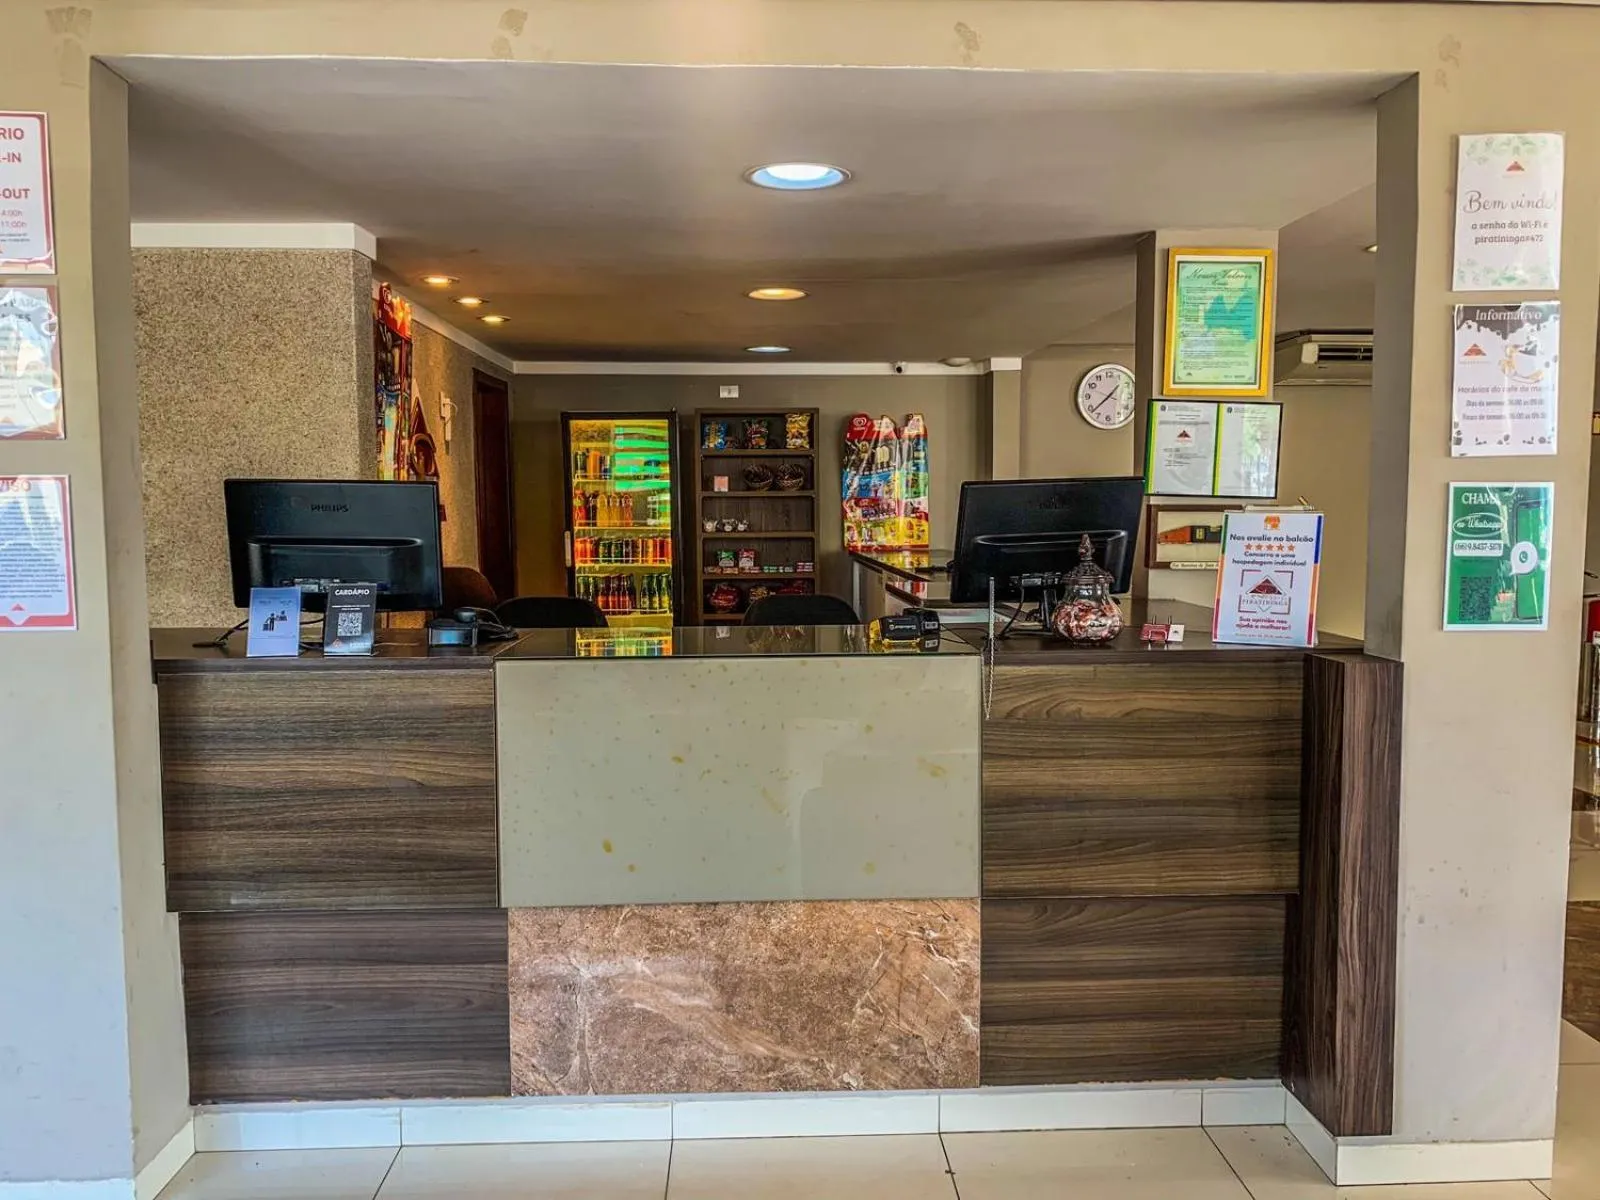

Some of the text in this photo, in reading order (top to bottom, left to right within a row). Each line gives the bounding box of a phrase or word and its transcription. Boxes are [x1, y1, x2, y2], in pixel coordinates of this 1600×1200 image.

[0, 152, 22, 163] -IN
[1463, 190, 1506, 214] Bem
[1479, 221, 1506, 230] senha
[1475, 308, 1542, 321] Informativo
[1085, 393, 1091, 401] 9
[311, 503, 349, 513] PHILIPS
[1246, 534, 1271, 542] avalie
[335, 588, 370, 597] CARDÁPIO
